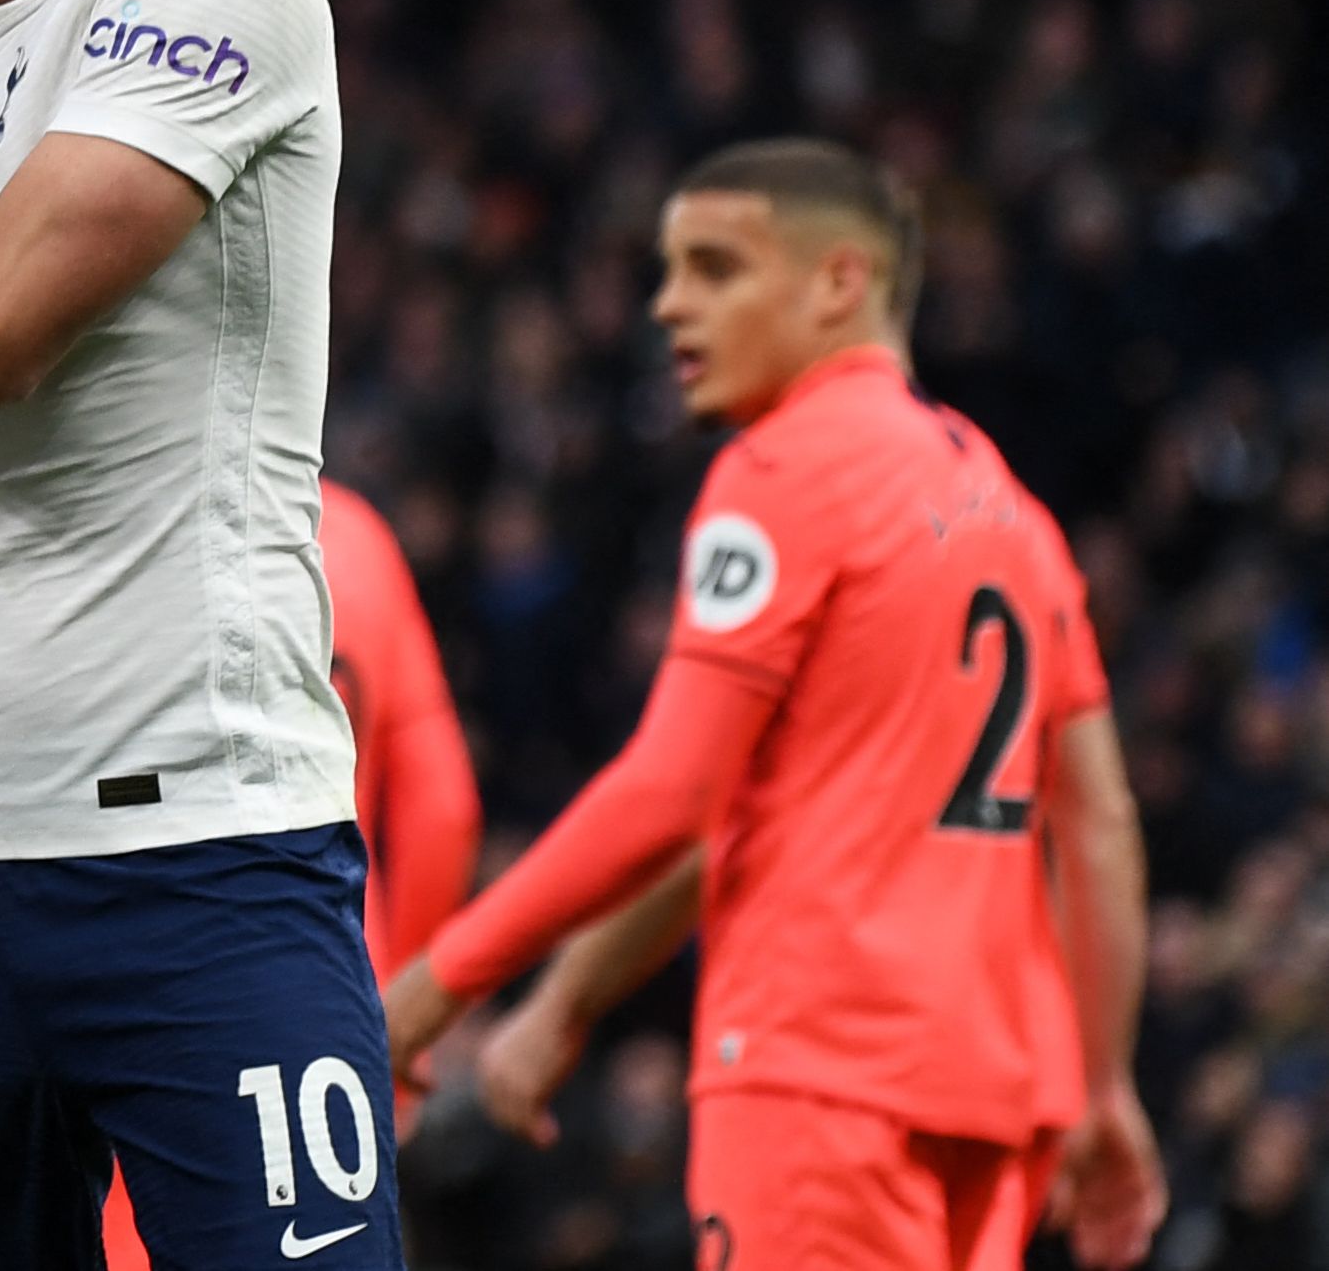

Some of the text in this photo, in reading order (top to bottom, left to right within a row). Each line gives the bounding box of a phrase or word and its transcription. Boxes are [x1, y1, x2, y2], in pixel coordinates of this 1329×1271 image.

[83, 0, 250, 96] cinch
[939, 585, 1033, 832] 2
[238, 1056, 378, 1206] 10
